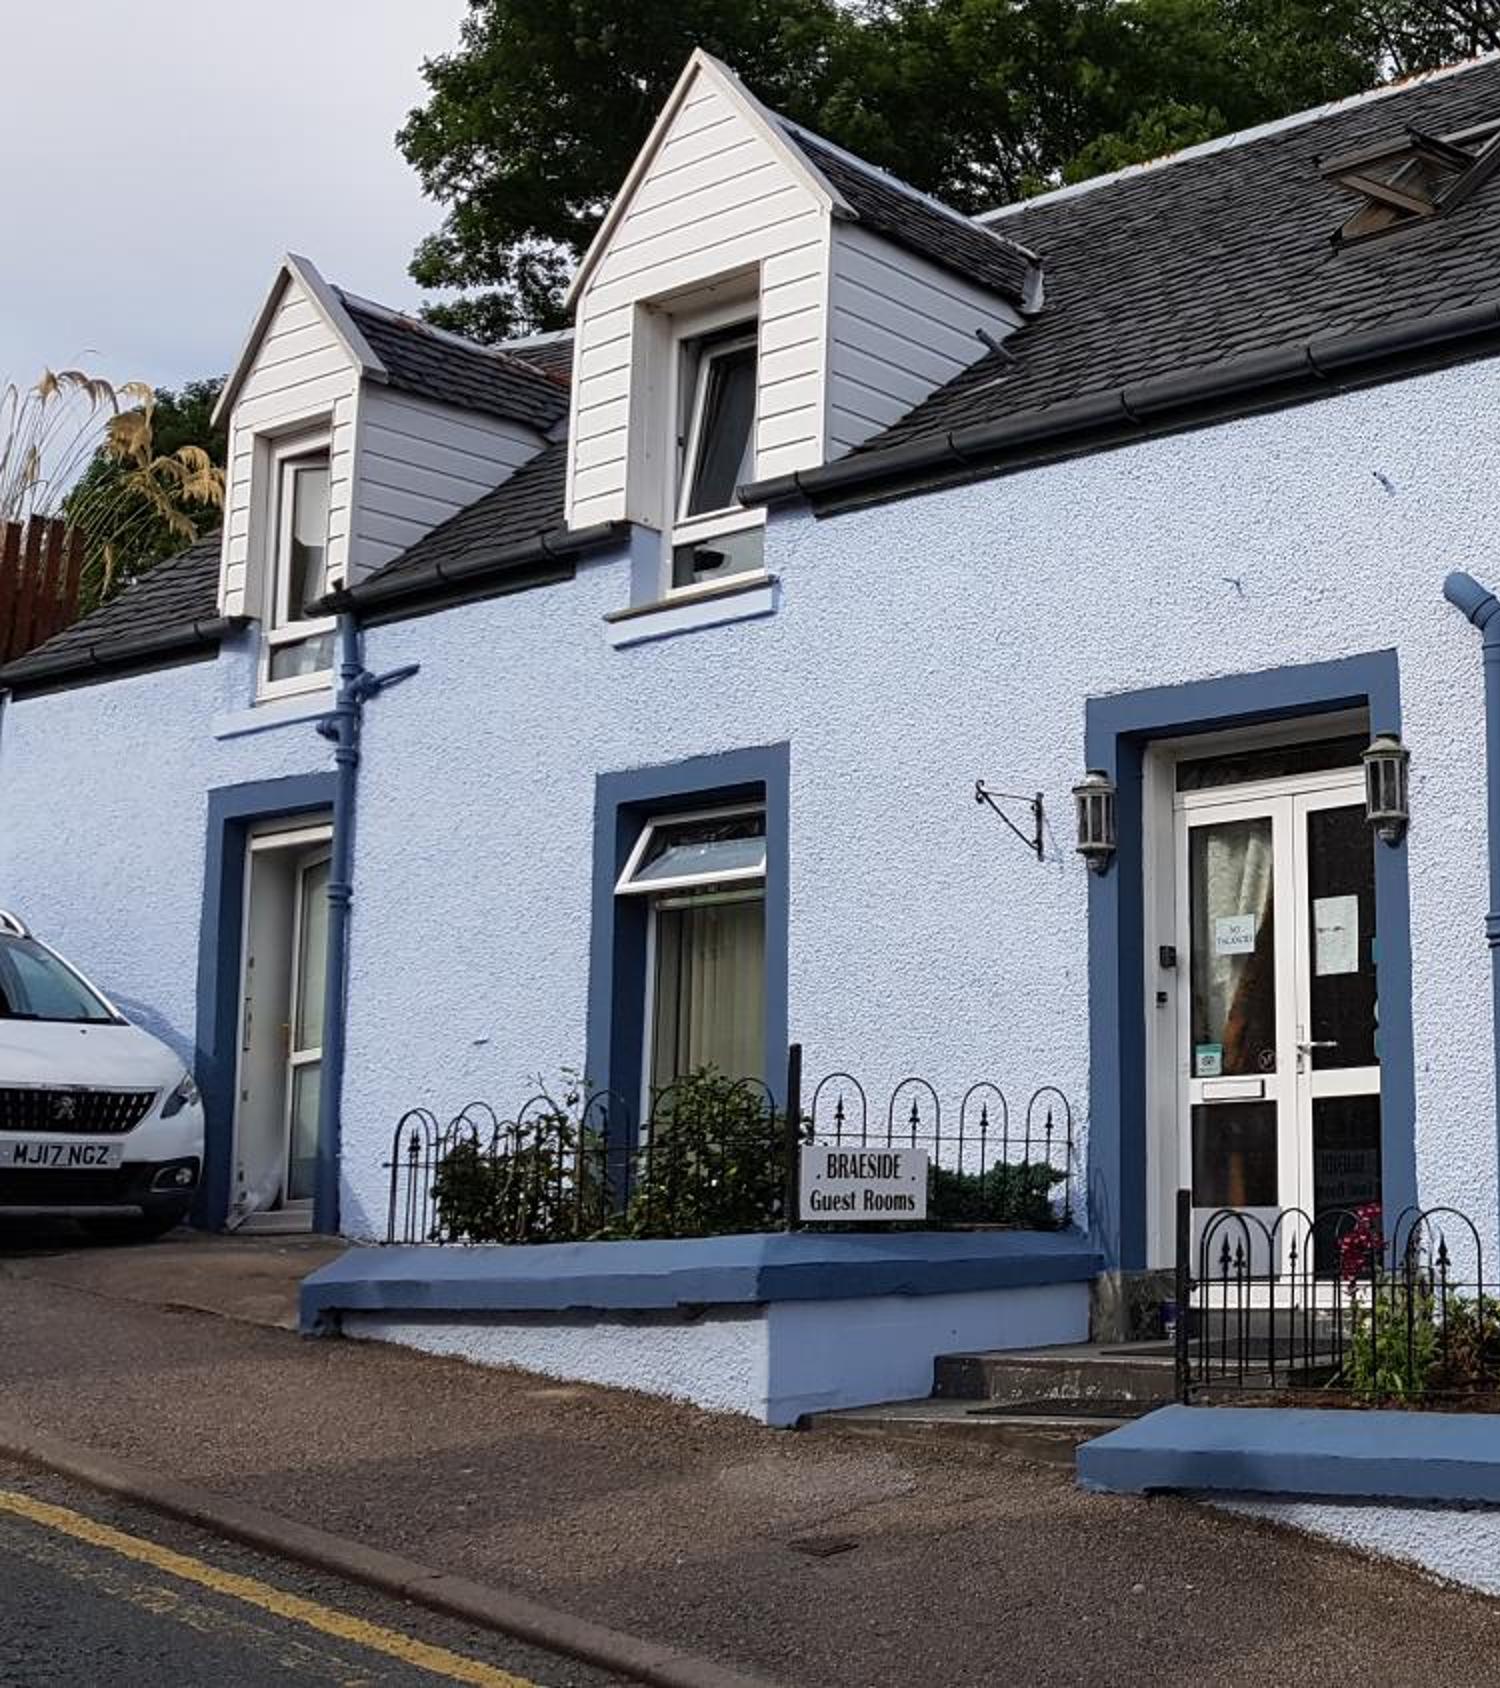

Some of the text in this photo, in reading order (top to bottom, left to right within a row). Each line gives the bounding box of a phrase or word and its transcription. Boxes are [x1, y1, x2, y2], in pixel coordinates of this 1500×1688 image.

[13, 1144, 110, 1165] MJ17 NGZ
[826, 1153, 902, 1179] BRAESIDE
[809, 1189, 915, 1211] Guest Rooms
